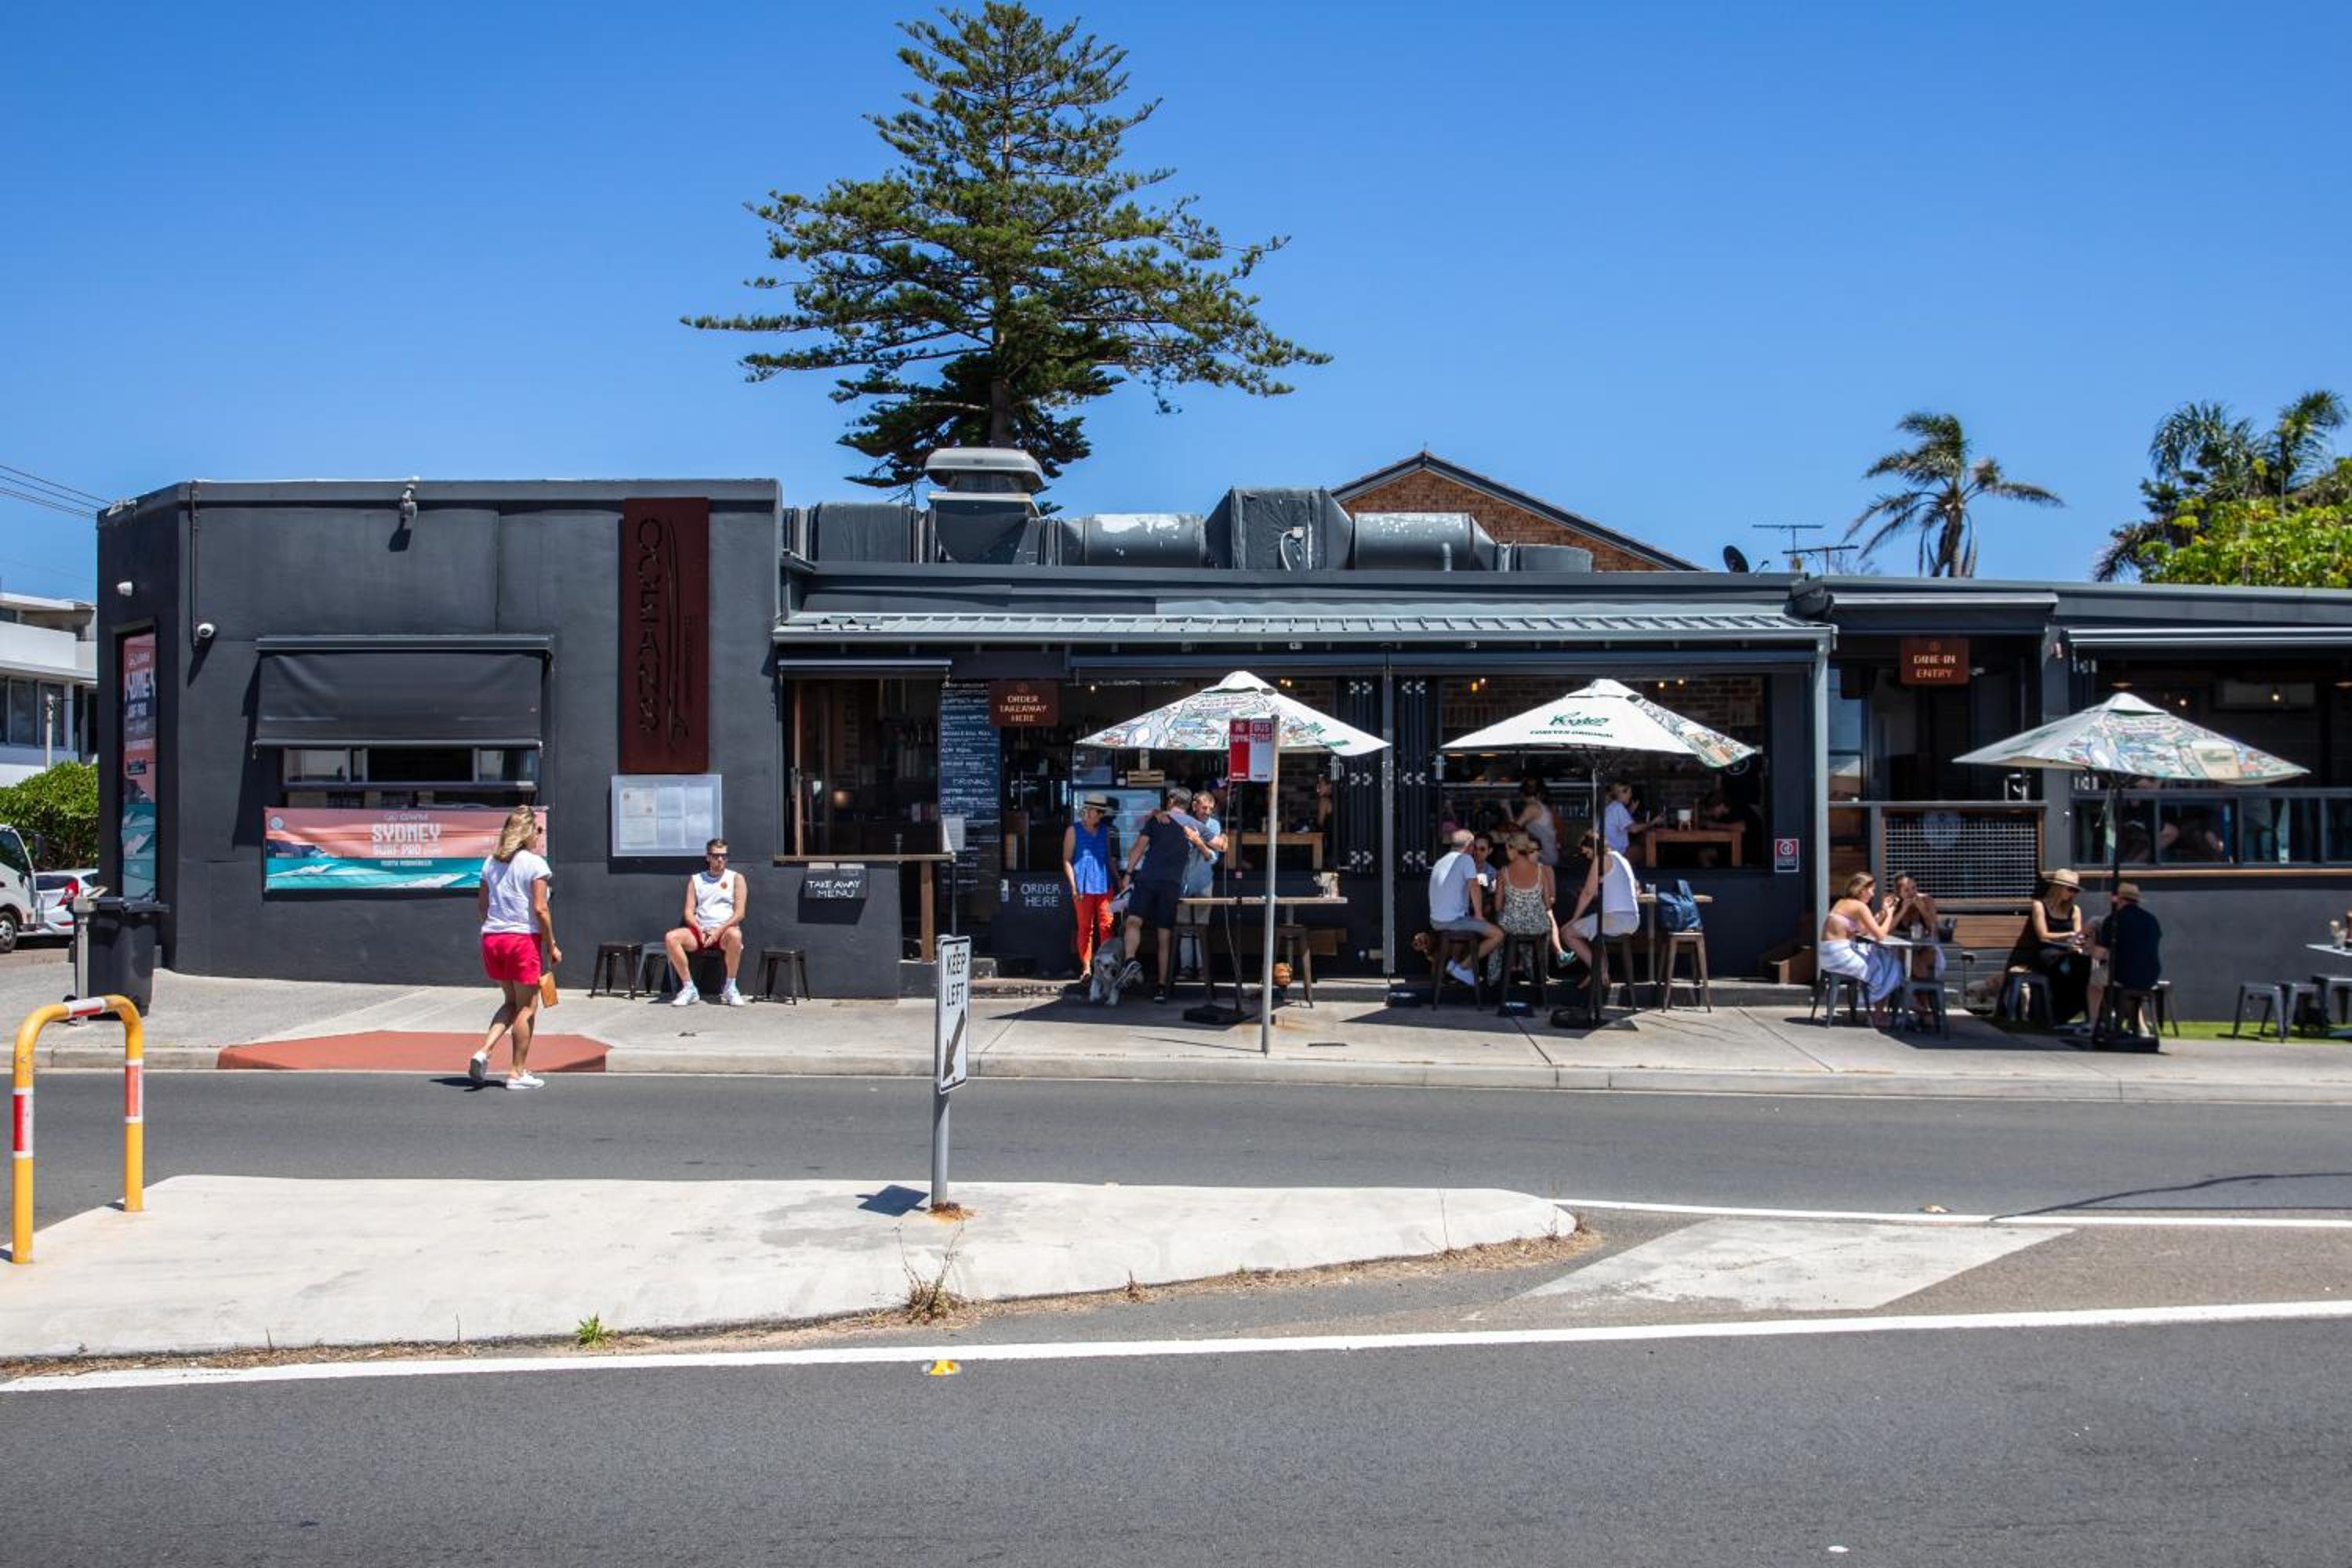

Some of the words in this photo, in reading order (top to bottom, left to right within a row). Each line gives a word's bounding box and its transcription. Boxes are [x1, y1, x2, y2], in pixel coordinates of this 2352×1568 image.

[1913, 655, 1956, 665] DINE-IN
[1916, 669, 1952, 678] ENTRY
[1254, 723, 1269, 733] BUS
[372, 823, 441, 843] SYDNEY
[372, 843, 399, 855] SURF
[401, 843, 421, 855] PRO
[807, 880, 833, 889] TAKE
[833, 880, 861, 889] AWAY
[1020, 883, 1060, 895] ORDER
[816, 889, 855, 898] MENU
[1025, 895, 1059, 907] HERE
[946, 952, 967, 975] KEEP
[946, 982, 965, 1007] LEFT
